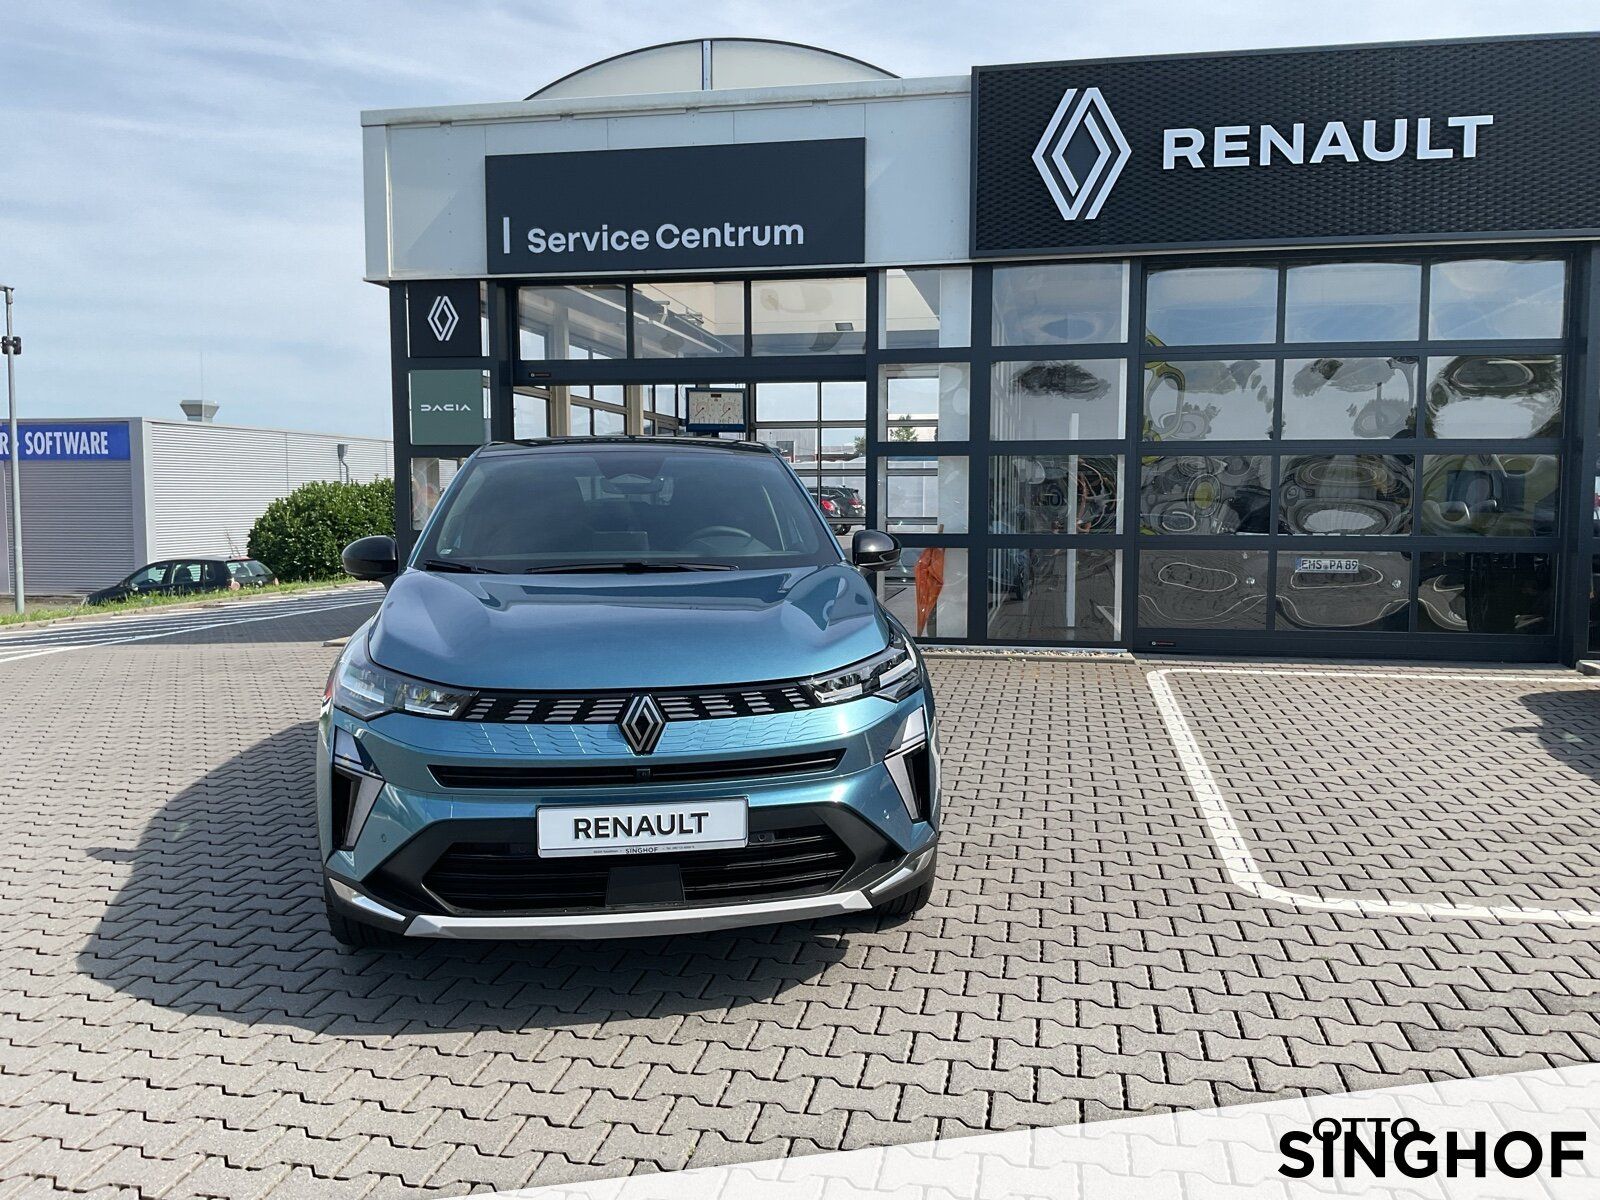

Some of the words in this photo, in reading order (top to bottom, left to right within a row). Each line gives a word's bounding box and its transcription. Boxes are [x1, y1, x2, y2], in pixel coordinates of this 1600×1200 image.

[1162, 114, 1494, 170] RENAULT
[527, 224, 650, 254] Service
[655, 222, 804, 250] Centrum
[420, 404, 472, 412] DACIA
[24, 431, 109, 455] SOFTWARE
[1329, 560, 1343, 570] PA
[1345, 560, 1358, 570] 89
[573, 811, 709, 840] RENAULT
[625, 846, 659, 854] SINGHOF
